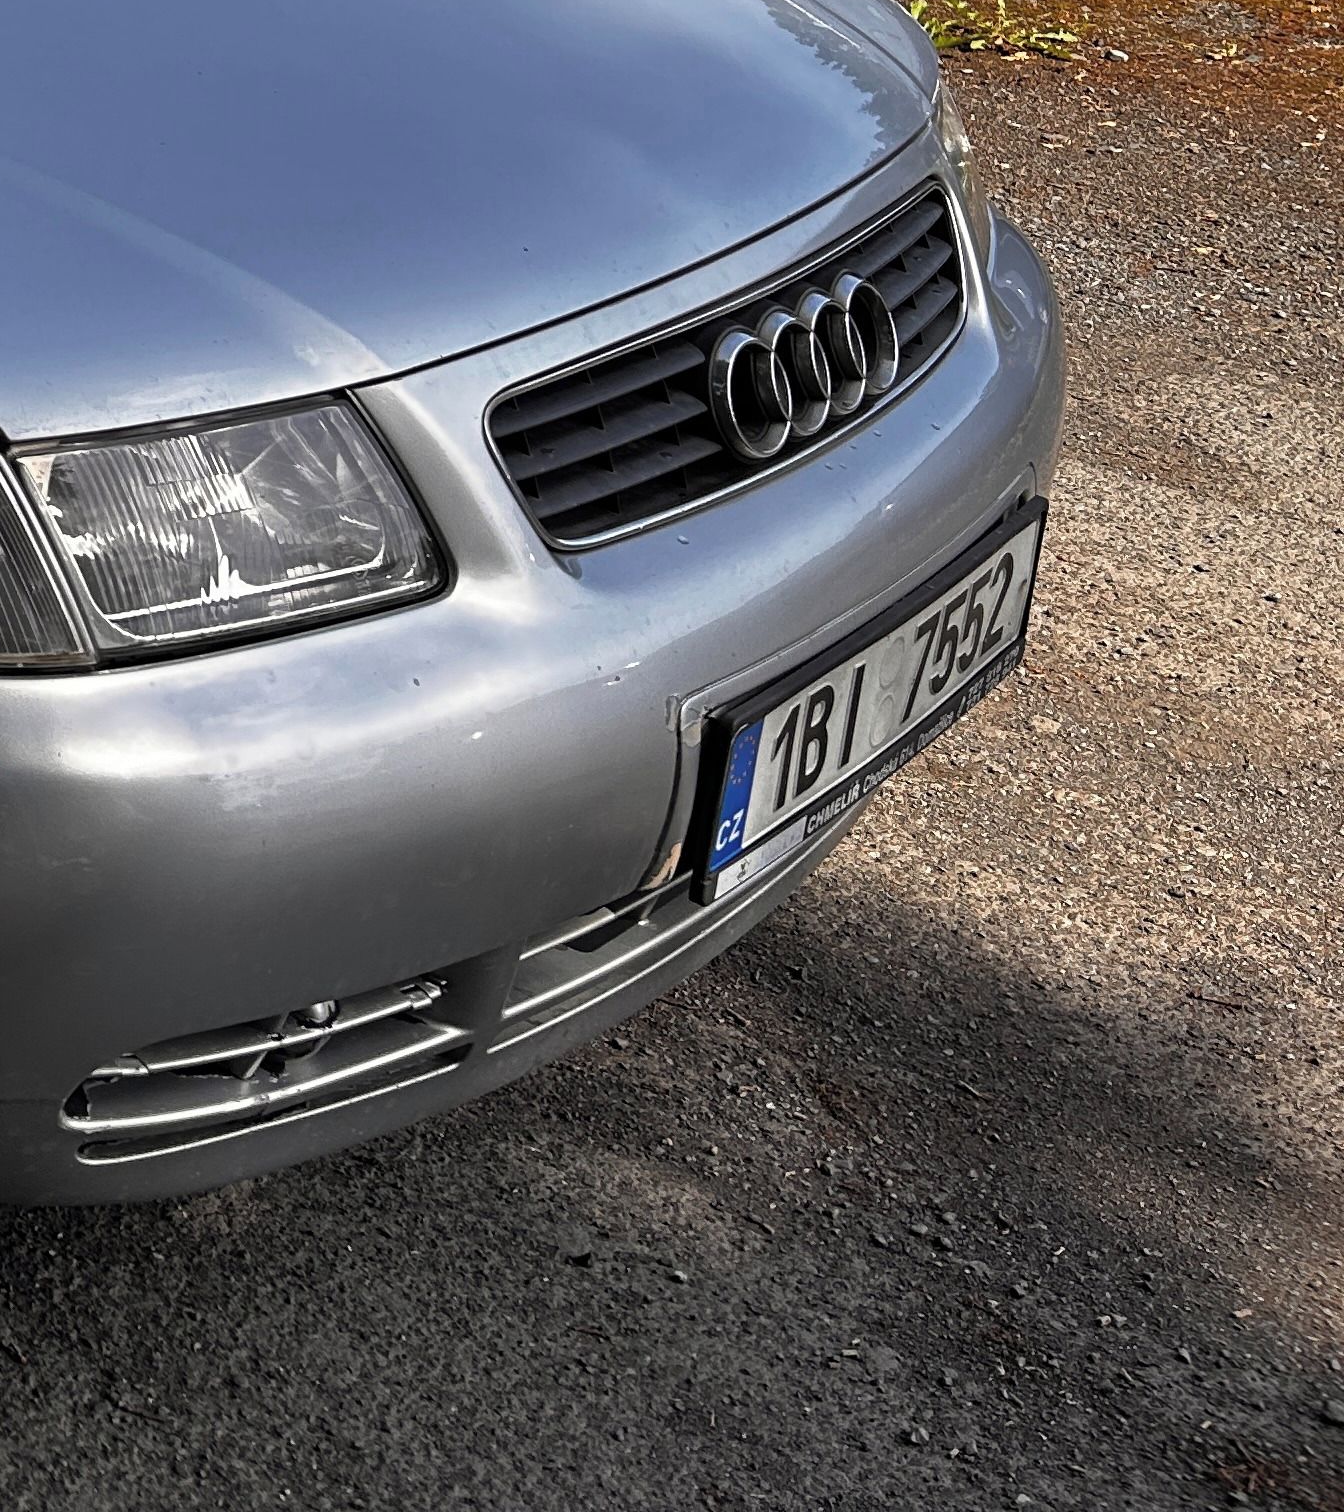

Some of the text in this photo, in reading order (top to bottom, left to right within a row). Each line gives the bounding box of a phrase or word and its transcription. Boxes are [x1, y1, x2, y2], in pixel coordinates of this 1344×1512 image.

[771, 552, 1014, 812] 1BI 7552
[714, 809, 744, 851] CZ
[807, 778, 860, 834] CHMELÍŘ
